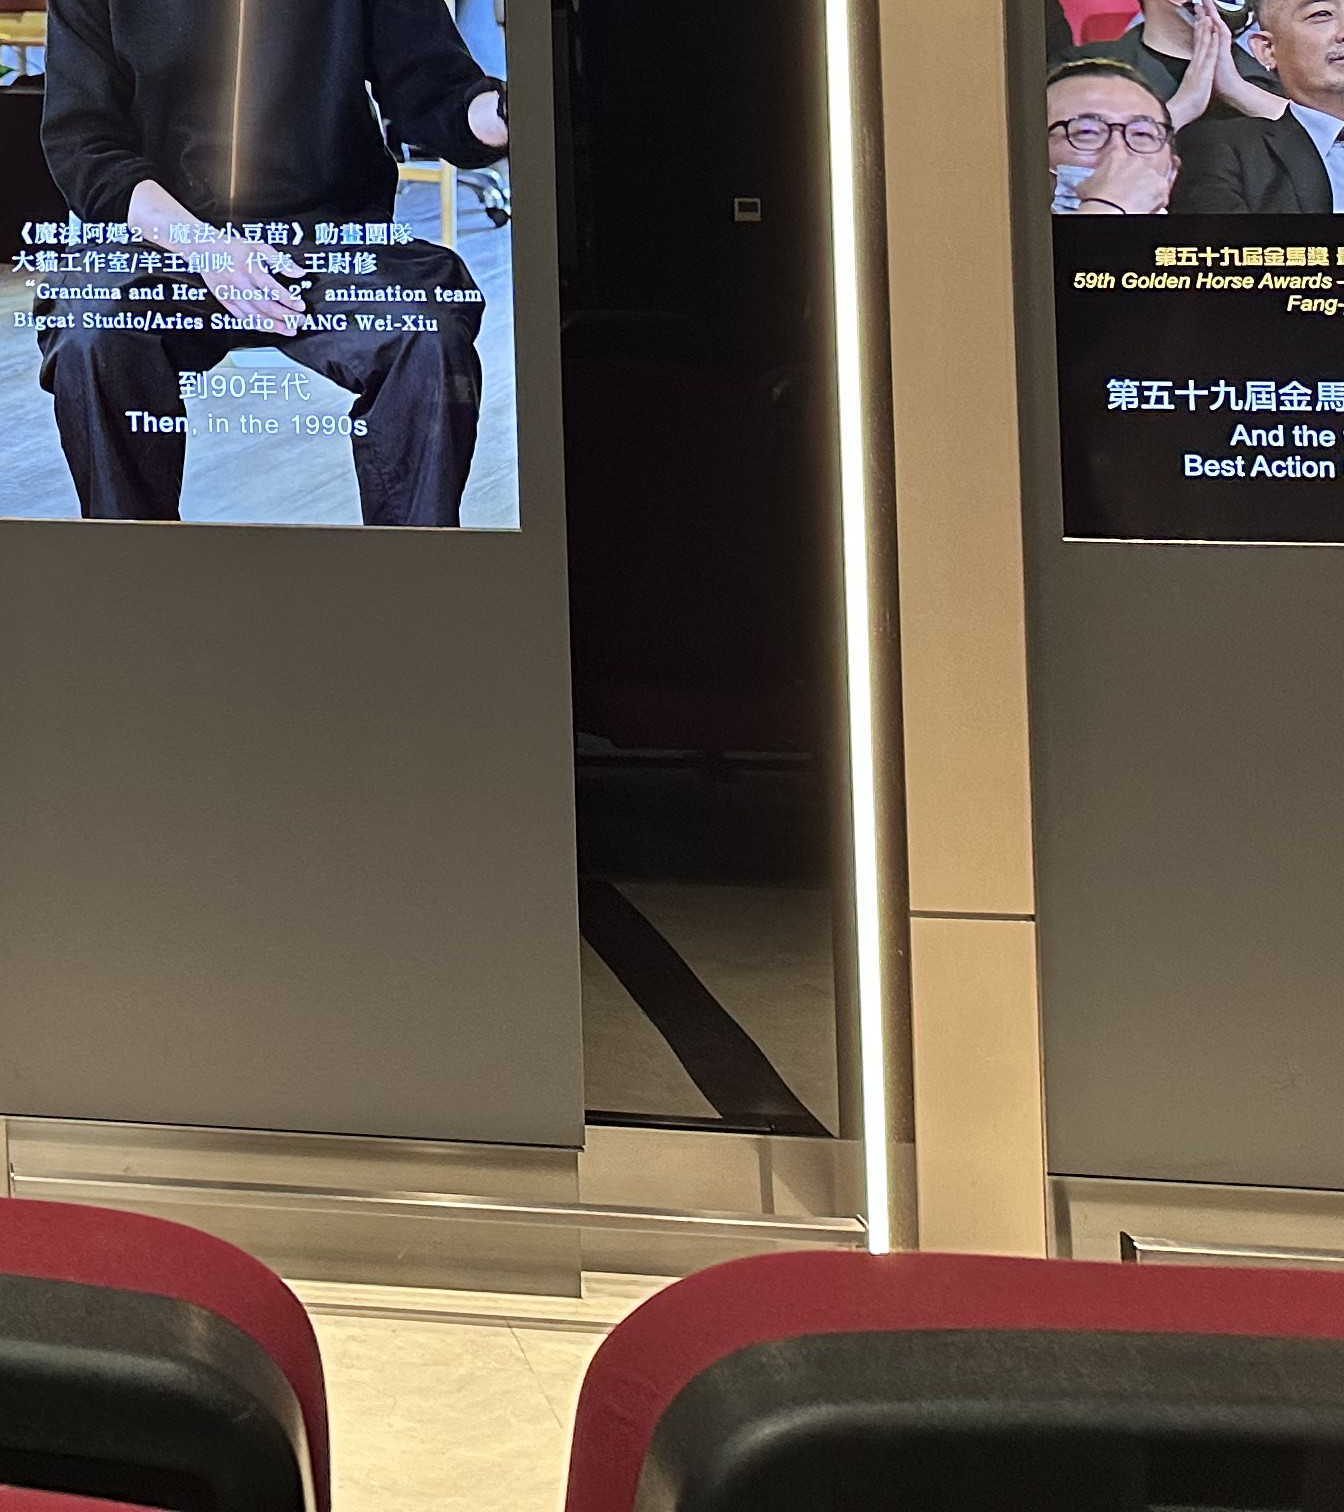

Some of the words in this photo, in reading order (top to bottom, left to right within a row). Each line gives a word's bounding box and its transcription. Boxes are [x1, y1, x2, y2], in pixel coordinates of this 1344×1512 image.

[246, 253, 292, 274] 代表
[303, 253, 377, 275] 王尉修
[1073, 272, 1115, 289] 59th
[1121, 272, 1190, 289] Golden
[1196, 272, 1254, 289] Horse
[1258, 272, 1332, 289] Awards
[128, 285, 165, 301] and
[172, 285, 208, 301] Her
[214, 285, 280, 302] Ghosts
[324, 285, 428, 302] animation
[434, 286, 482, 302] team
[13, 312, 76, 330] Bigcat
[82, 311, 204, 331] Studio/Aries
[211, 313, 274, 330] Studio
[283, 314, 347, 331] WANG
[355, 315, 438, 331] Wei-Xiu
[178, 371, 311, 401] 到90年代
[125, 411, 197, 435] Then,
[208, 413, 229, 432] in
[240, 414, 279, 434] the
[291, 414, 368, 436] 1990s
[1230, 425, 1284, 447] And
[1293, 426, 1336, 447] the
[1184, 455, 1246, 477] Best
[1250, 455, 1336, 477] Action
